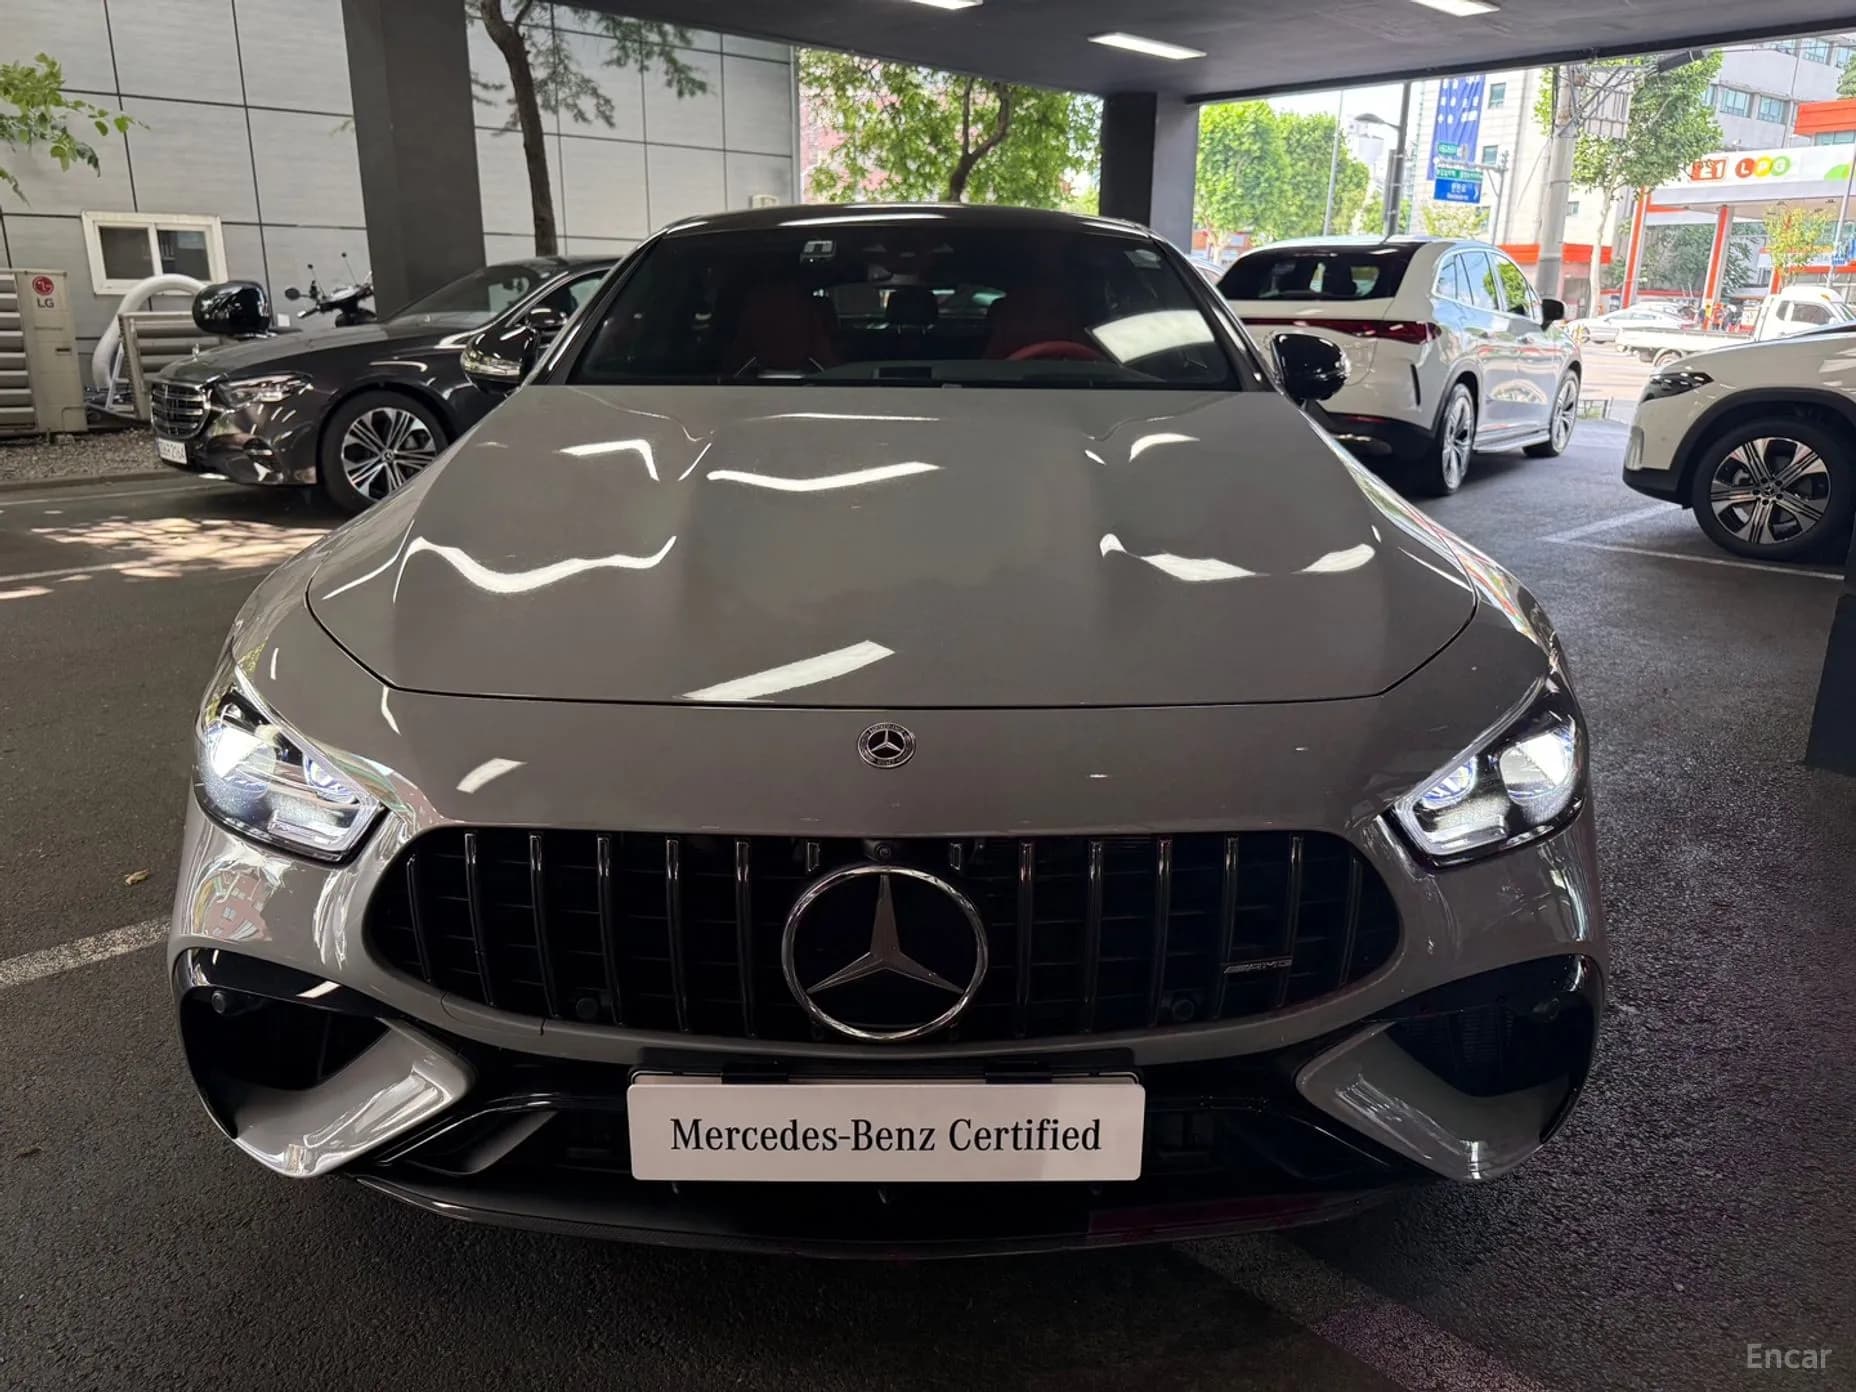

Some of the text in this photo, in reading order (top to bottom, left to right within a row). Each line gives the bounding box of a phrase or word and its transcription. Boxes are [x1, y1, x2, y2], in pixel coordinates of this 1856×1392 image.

[1738, 158, 1787, 176] LPG
[37, 298, 54, 309] LG
[670, 1117, 1103, 1151] Mercedes-Benz Certified
